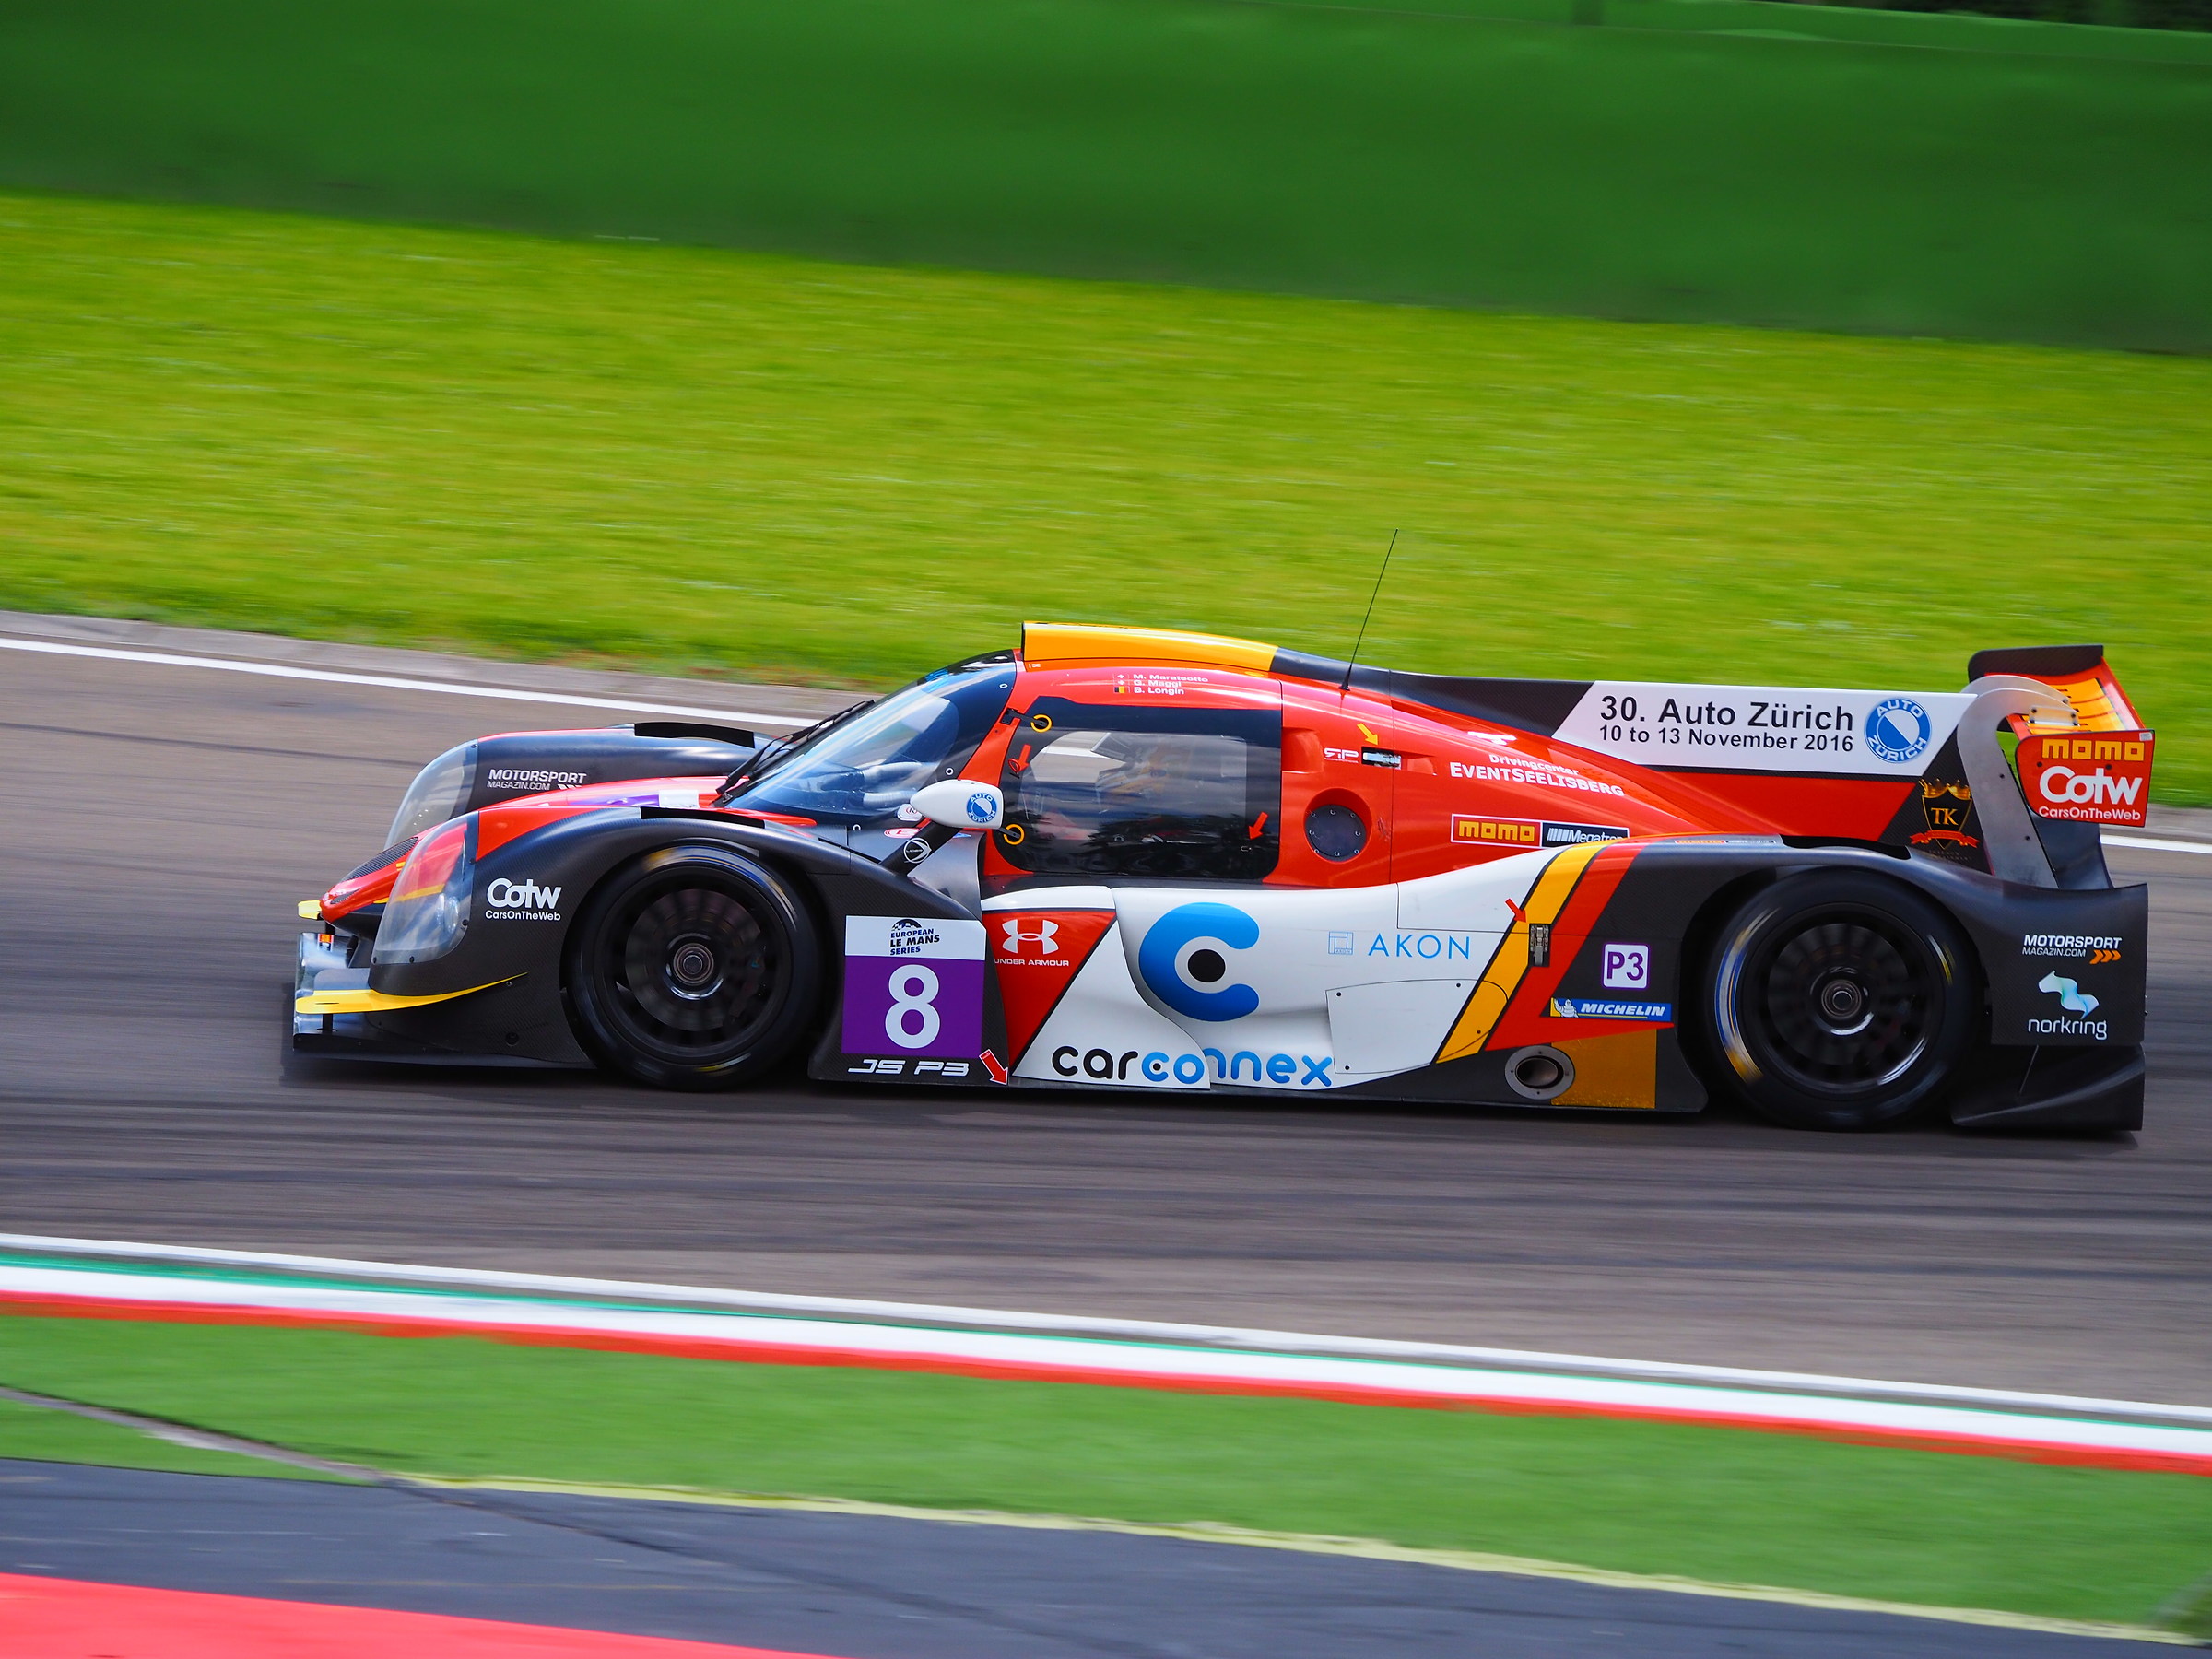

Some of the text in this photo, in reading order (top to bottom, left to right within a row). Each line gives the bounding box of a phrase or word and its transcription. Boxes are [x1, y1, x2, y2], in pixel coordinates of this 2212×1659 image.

[1147, 687, 1185, 696] Longin
[1600, 695, 1853, 731] 30. Auto Zürich
[1877, 700, 1924, 718] AUTO
[1599, 724, 1853, 752] 10 to 13 November 2016
[1488, 754, 1579, 776] Drivingcenter
[488, 769, 587, 784] MOTORSPORT
[487, 781, 551, 791] MAGAZIN.COM
[971, 792, 994, 802] AUTO
[1931, 807, 1959, 826] TK
[2038, 806, 2141, 820] CarsOnTheWeb
[485, 910, 561, 921] CarsOnTheWeb
[890, 928, 935, 938] EUROPEAN
[890, 935, 940, 947] LE MANS
[1368, 933, 1470, 959] AKON
[2023, 934, 2123, 949] MOTORSPORT
[889, 946, 922, 956] SERIES
[2022, 947, 2087, 958] MAGAZIN.COM
[1606, 951, 1644, 981] P3
[885, 963, 941, 1049] 8
[1581, 1003, 1665, 1017] MICHELIN
[2028, 1015, 2108, 1041] norkring
